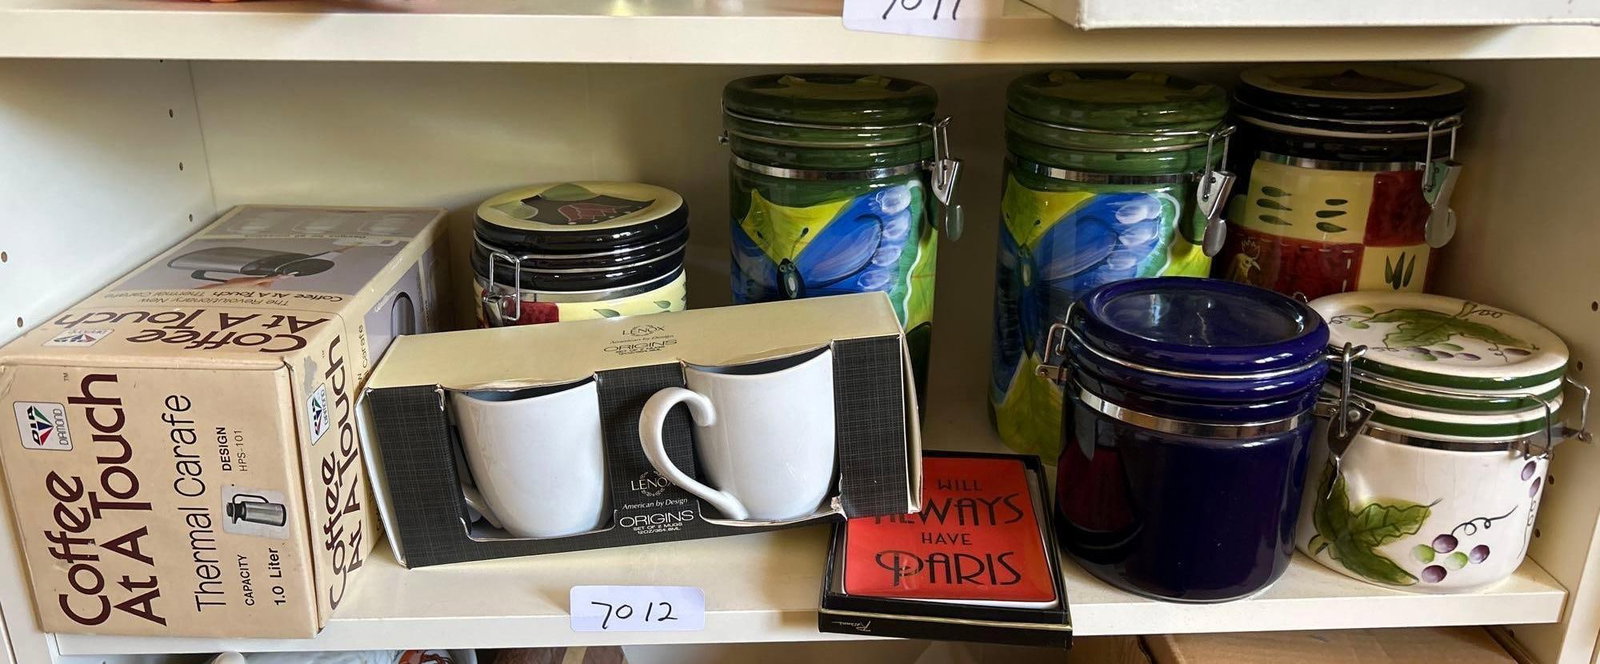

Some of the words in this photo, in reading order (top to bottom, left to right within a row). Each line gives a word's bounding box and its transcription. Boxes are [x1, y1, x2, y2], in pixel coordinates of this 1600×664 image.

[266, 299, 290, 307] The
[294, 293, 343, 303] Coffee
[54, 309, 205, 331] Touch
[218, 312, 262, 331] A
[262, 315, 330, 334] At
[125, 329, 308, 353] Coffee
[357, 324, 368, 368] Carafe
[604, 339, 678, 352] ORIGINS
[26, 405, 43, 446] DIA
[52, 408, 69, 446] DIAMOND
[324, 334, 359, 487] Touch
[67, 373, 153, 520] Touch
[161, 394, 206, 498] Carafe
[215, 427, 232, 471] DESIGN
[238, 429, 249, 472] HPS-101
[342, 475, 360, 514] A
[622, 501, 655, 510] American
[655, 500, 665, 508] by
[665, 498, 688, 506] Design
[937, 479, 983, 491] WILL
[320, 451, 348, 610] Coffee
[619, 510, 694, 528] ORIGINS
[44, 470, 112, 626] Coffee
[100, 526, 155, 567] A
[345, 520, 363, 574] At
[921, 532, 973, 546] HAVE
[177, 507, 227, 612] Thermal
[268, 547, 283, 579] Liter
[875, 550, 1021, 586] PARIS
[236, 554, 255, 607] CAPACITY
[271, 585, 287, 606] 1.0
[112, 574, 167, 627] At
[591, 601, 678, 630] 7012
